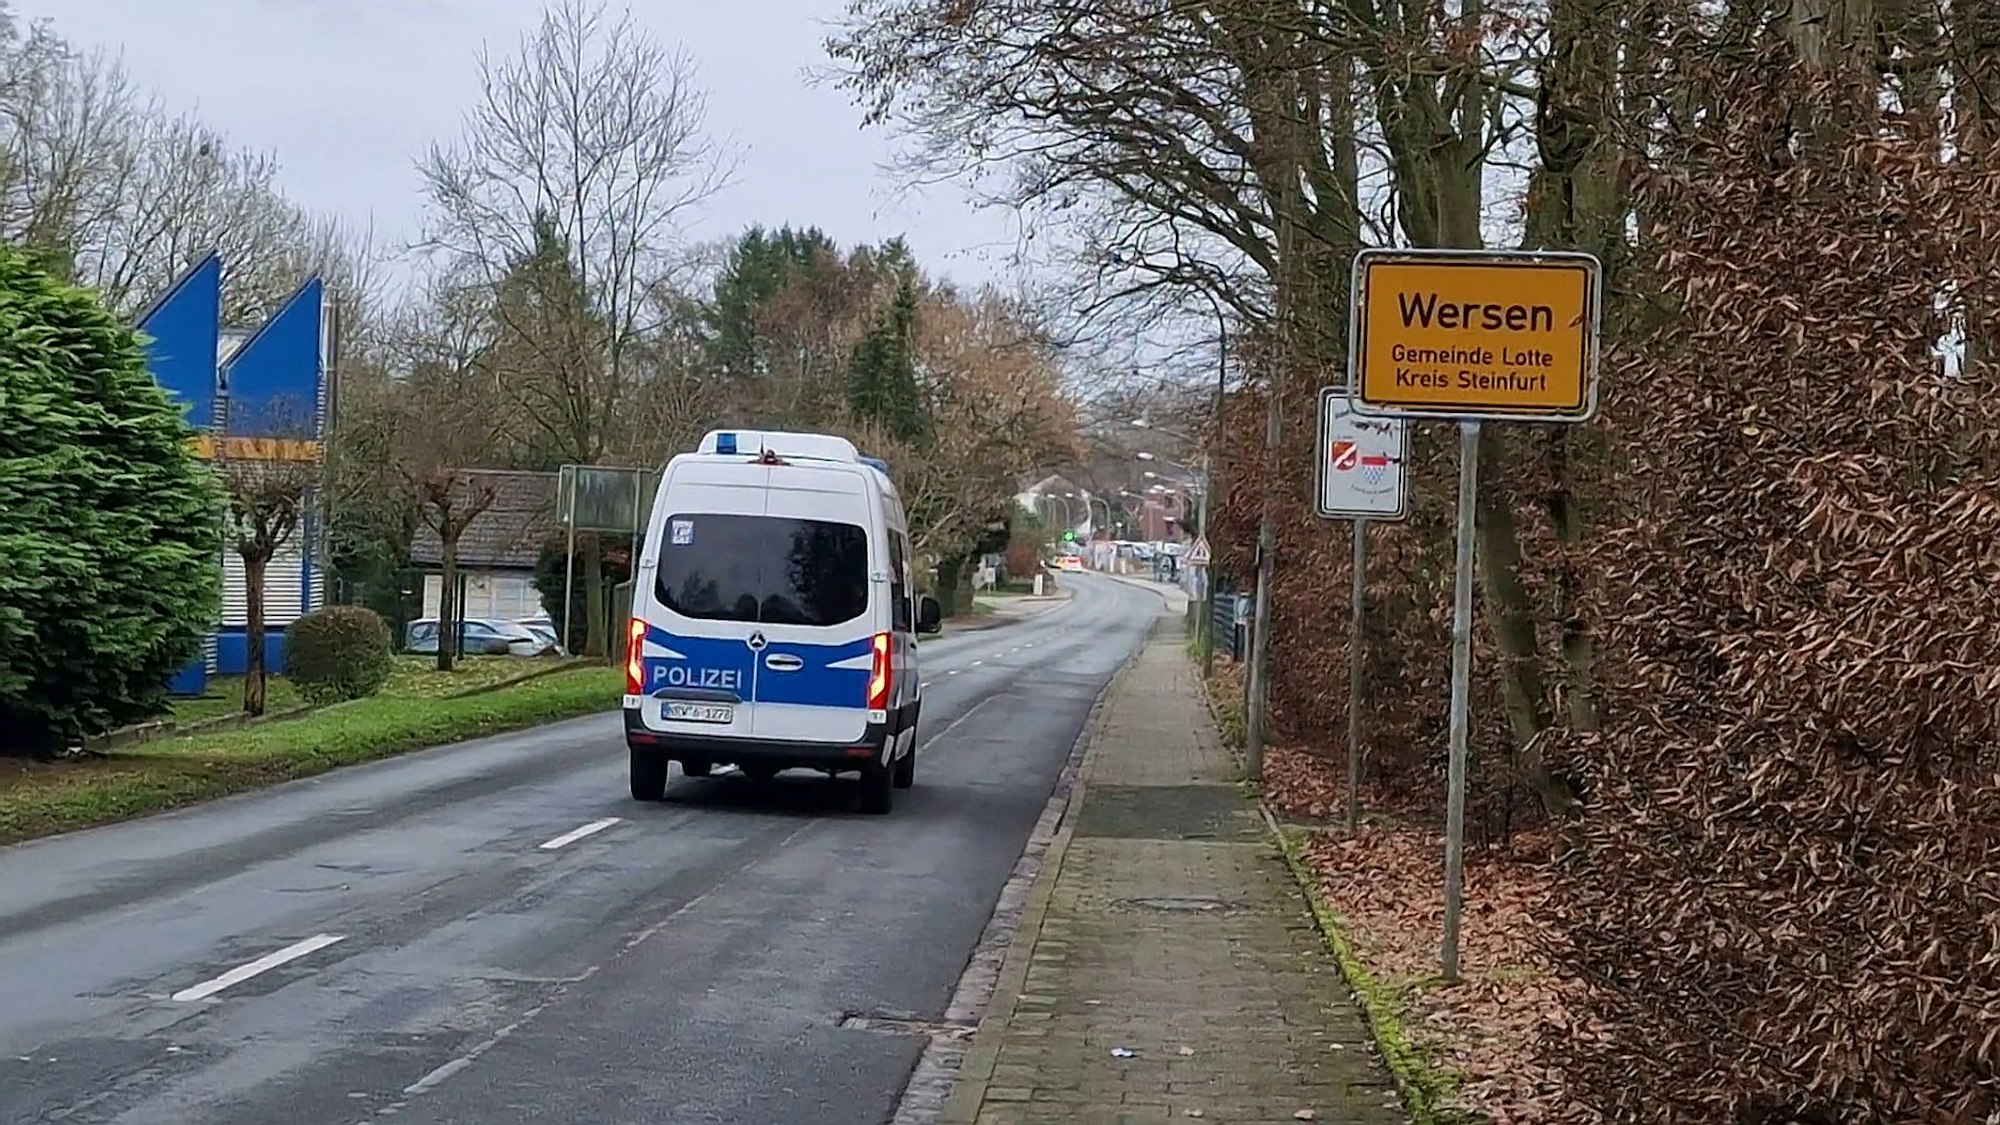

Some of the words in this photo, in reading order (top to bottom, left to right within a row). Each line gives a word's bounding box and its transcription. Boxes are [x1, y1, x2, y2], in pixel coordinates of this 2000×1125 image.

[1398, 291, 1553, 332] Wersen
[1392, 344, 1493, 366] Gemeinde
[1502, 347, 1553, 367] Lotte
[1396, 367, 1449, 388] Kreis
[1457, 370, 1546, 392] Steinfurt
[653, 665, 742, 690] POLIZEI
